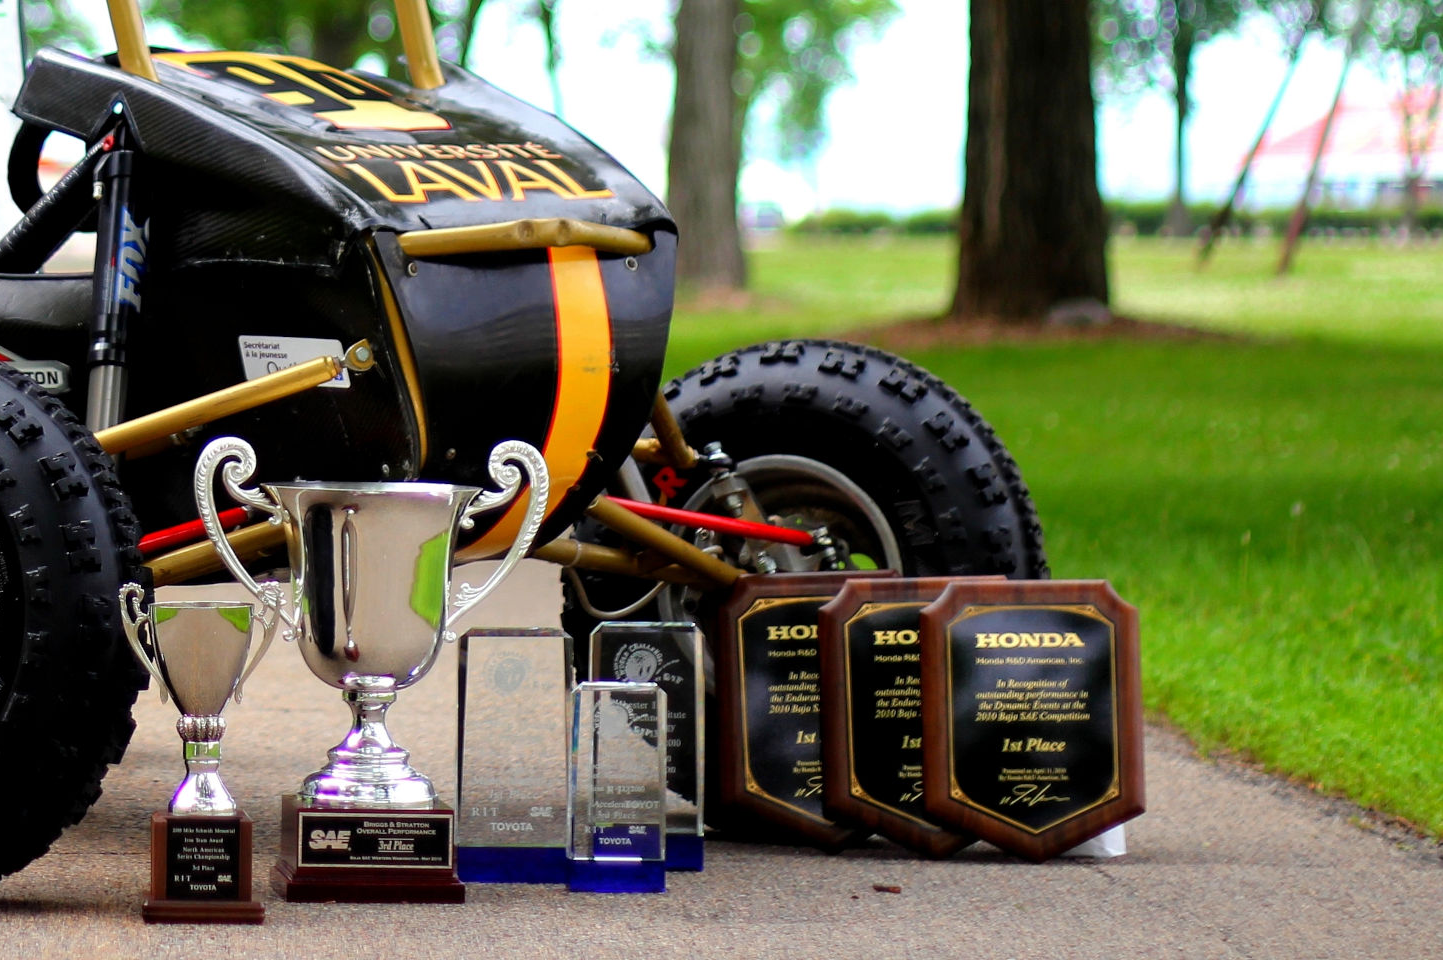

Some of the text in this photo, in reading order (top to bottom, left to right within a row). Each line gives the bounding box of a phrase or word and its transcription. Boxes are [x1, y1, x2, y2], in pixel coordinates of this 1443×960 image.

[316, 141, 562, 162] UNIVERSITÉ
[344, 159, 616, 204] LAVAL
[117, 207, 149, 313] FOX
[244, 341, 280, 350] Secrétariat
[259, 351, 288, 359] jeunesse
[975, 632, 1085, 648] HONDA
[874, 654, 902, 662] Honda
[975, 657, 1004, 665] Honda
[1069, 657, 1085, 665] Inc.
[789, 671, 798, 680] In
[894, 676, 904, 685] In
[768, 683, 816, 693] outstanding
[996, 679, 1068, 690] In Recognition of
[770, 694, 784, 703] the
[975, 691, 1089, 701] outstanding performance in
[877, 698, 890, 707] the
[979, 701, 1086, 712] the Dynamic Events at the
[769, 704, 791, 714] 2010
[791, 704, 811, 714] Baja
[875, 709, 917, 719] 2010 Baja
[975, 711, 1090, 723] 2010 Baja SAE Competition
[796, 730, 817, 744] 1st
[901, 735, 922, 749] 1st
[1002, 738, 1066, 753] 1st Place
[490, 822, 533, 831] TOYOTA
[309, 829, 352, 851] SAE
[599, 837, 632, 845] TOYOTA
[378, 840, 414, 851] 3rd Place
[193, 853, 231, 861] Championship
[217, 874, 232, 883] SAE
